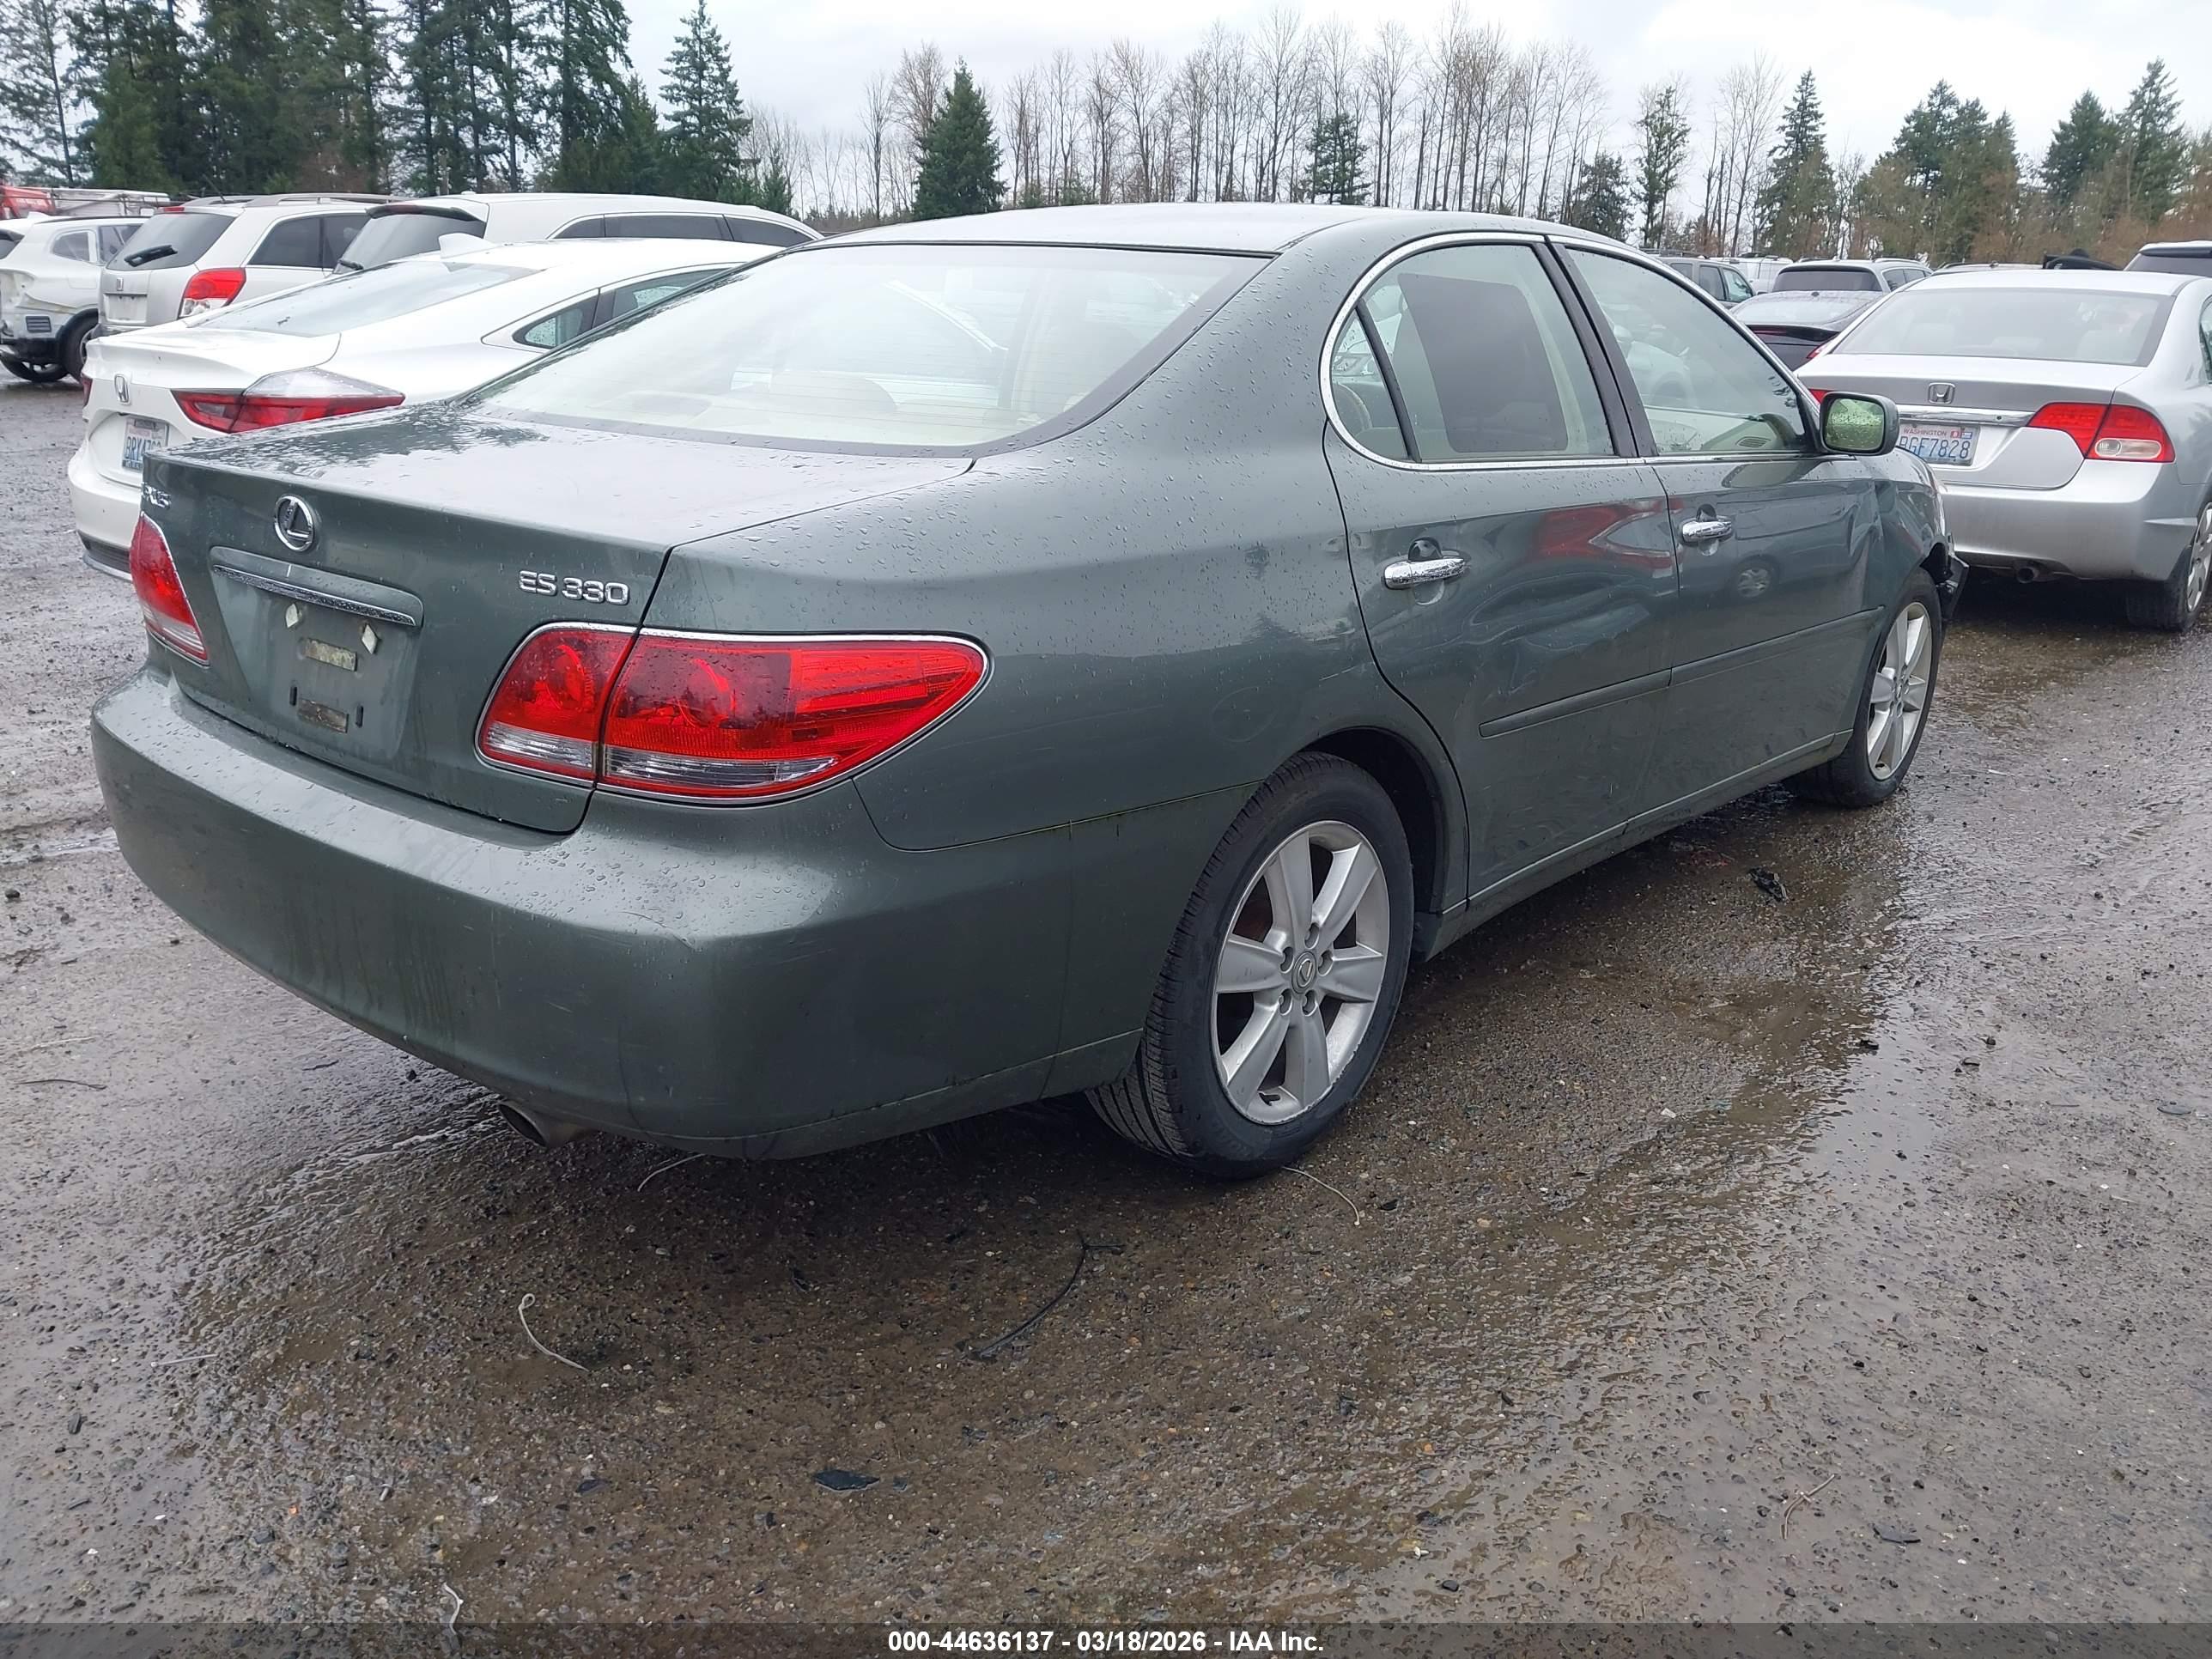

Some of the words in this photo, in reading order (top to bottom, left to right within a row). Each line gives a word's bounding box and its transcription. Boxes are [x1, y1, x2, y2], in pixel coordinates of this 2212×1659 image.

[1903, 427, 1947, 436] WASHINGTON
[1899, 436, 1971, 459] BGF7828
[519, 570, 557, 597] ES
[562, 577, 629, 605] 330
